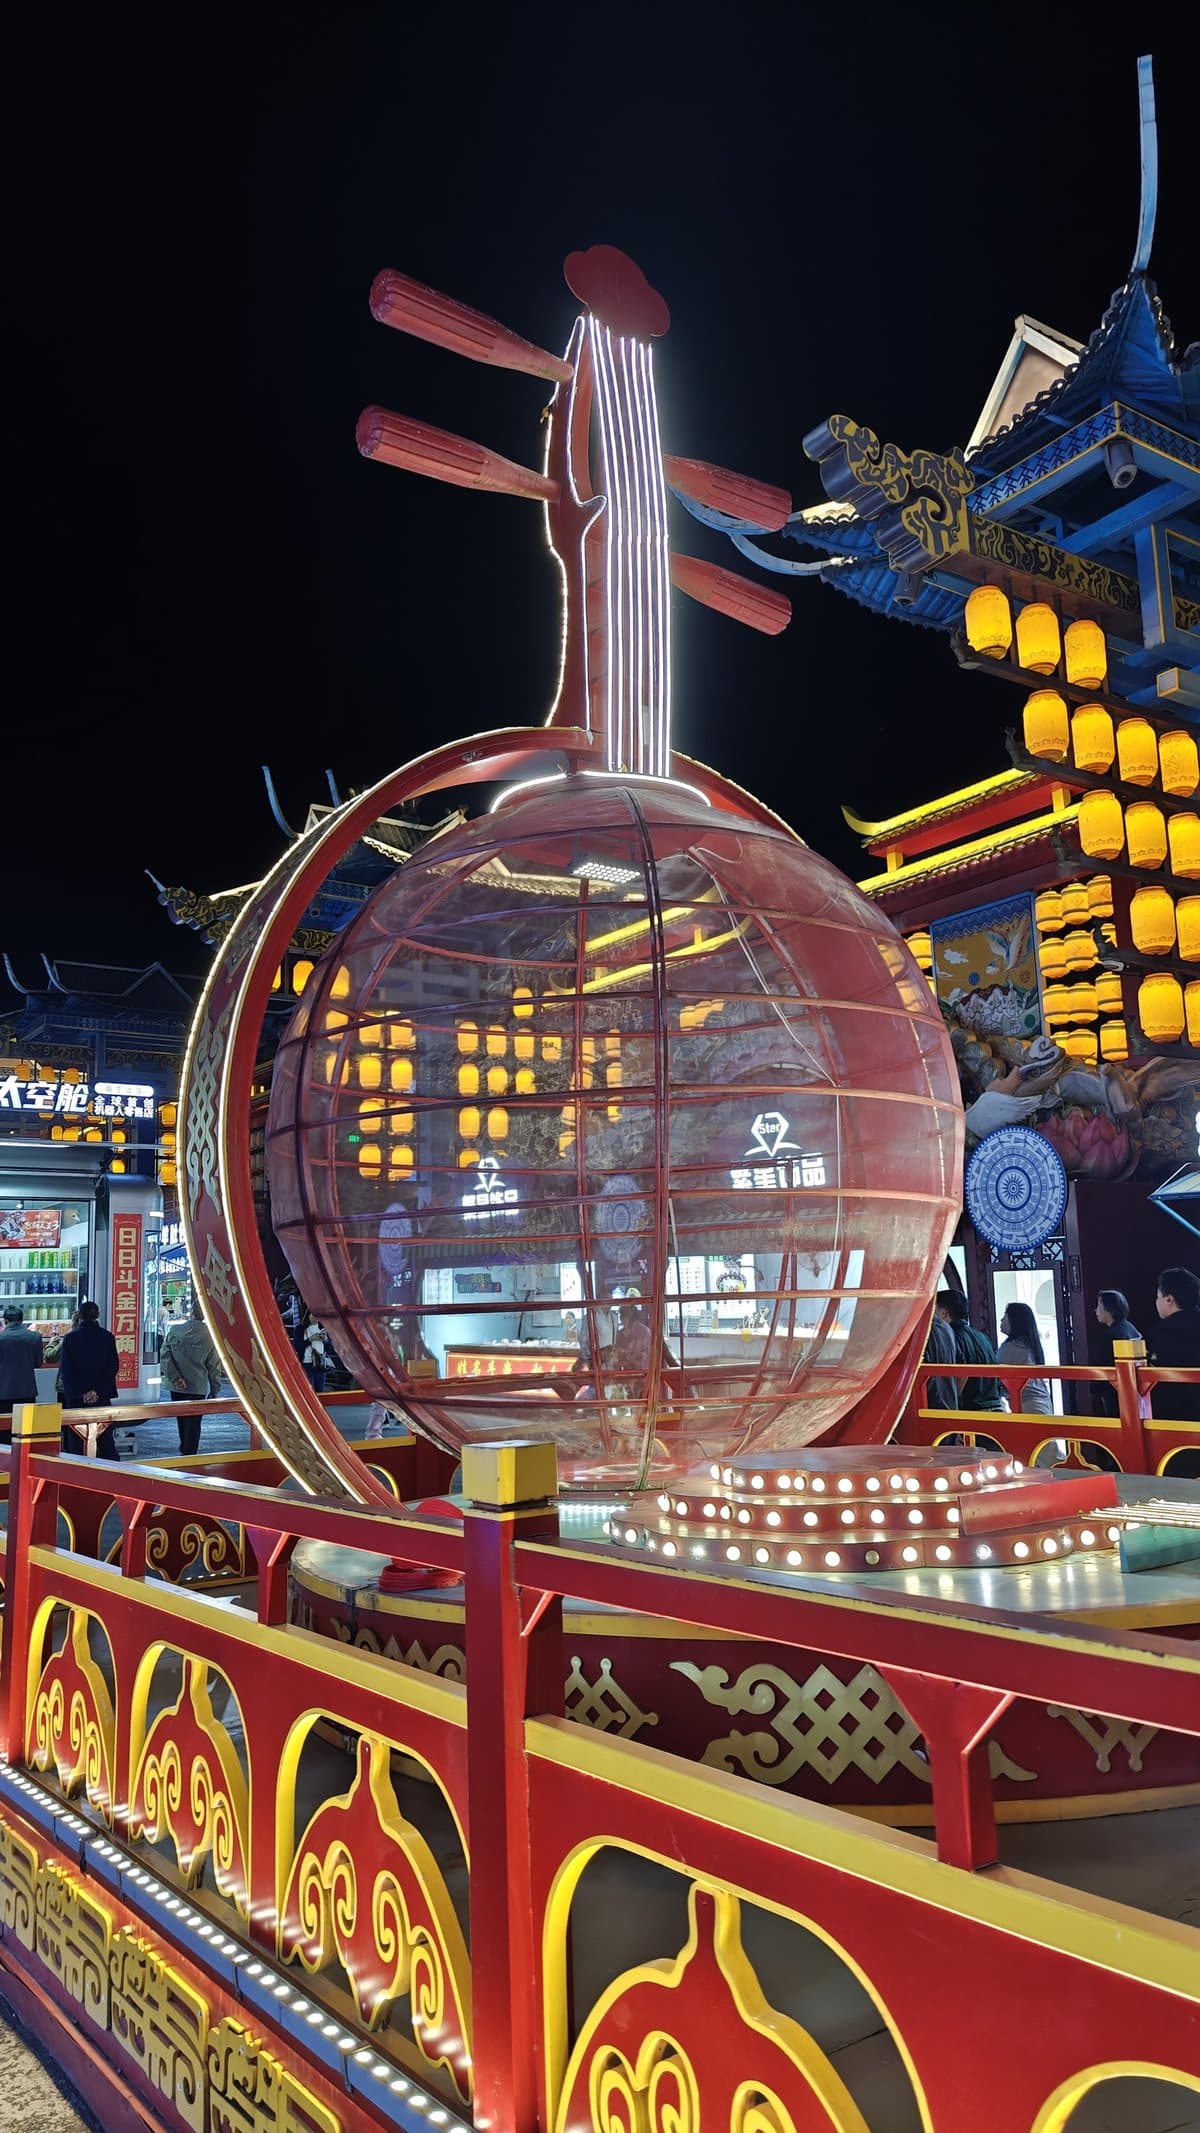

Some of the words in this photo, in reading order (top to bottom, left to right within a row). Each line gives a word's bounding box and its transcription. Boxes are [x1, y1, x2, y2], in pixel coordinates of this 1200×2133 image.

[0, 1075, 89, 1112] 太空舱
[94, 1095, 153, 1108] 全球首创
[94, 1103, 154, 1119] 机器人零售店
[759, 1121, 781, 1134] Star
[115, 1227, 138, 1355] 日日斗金万两
